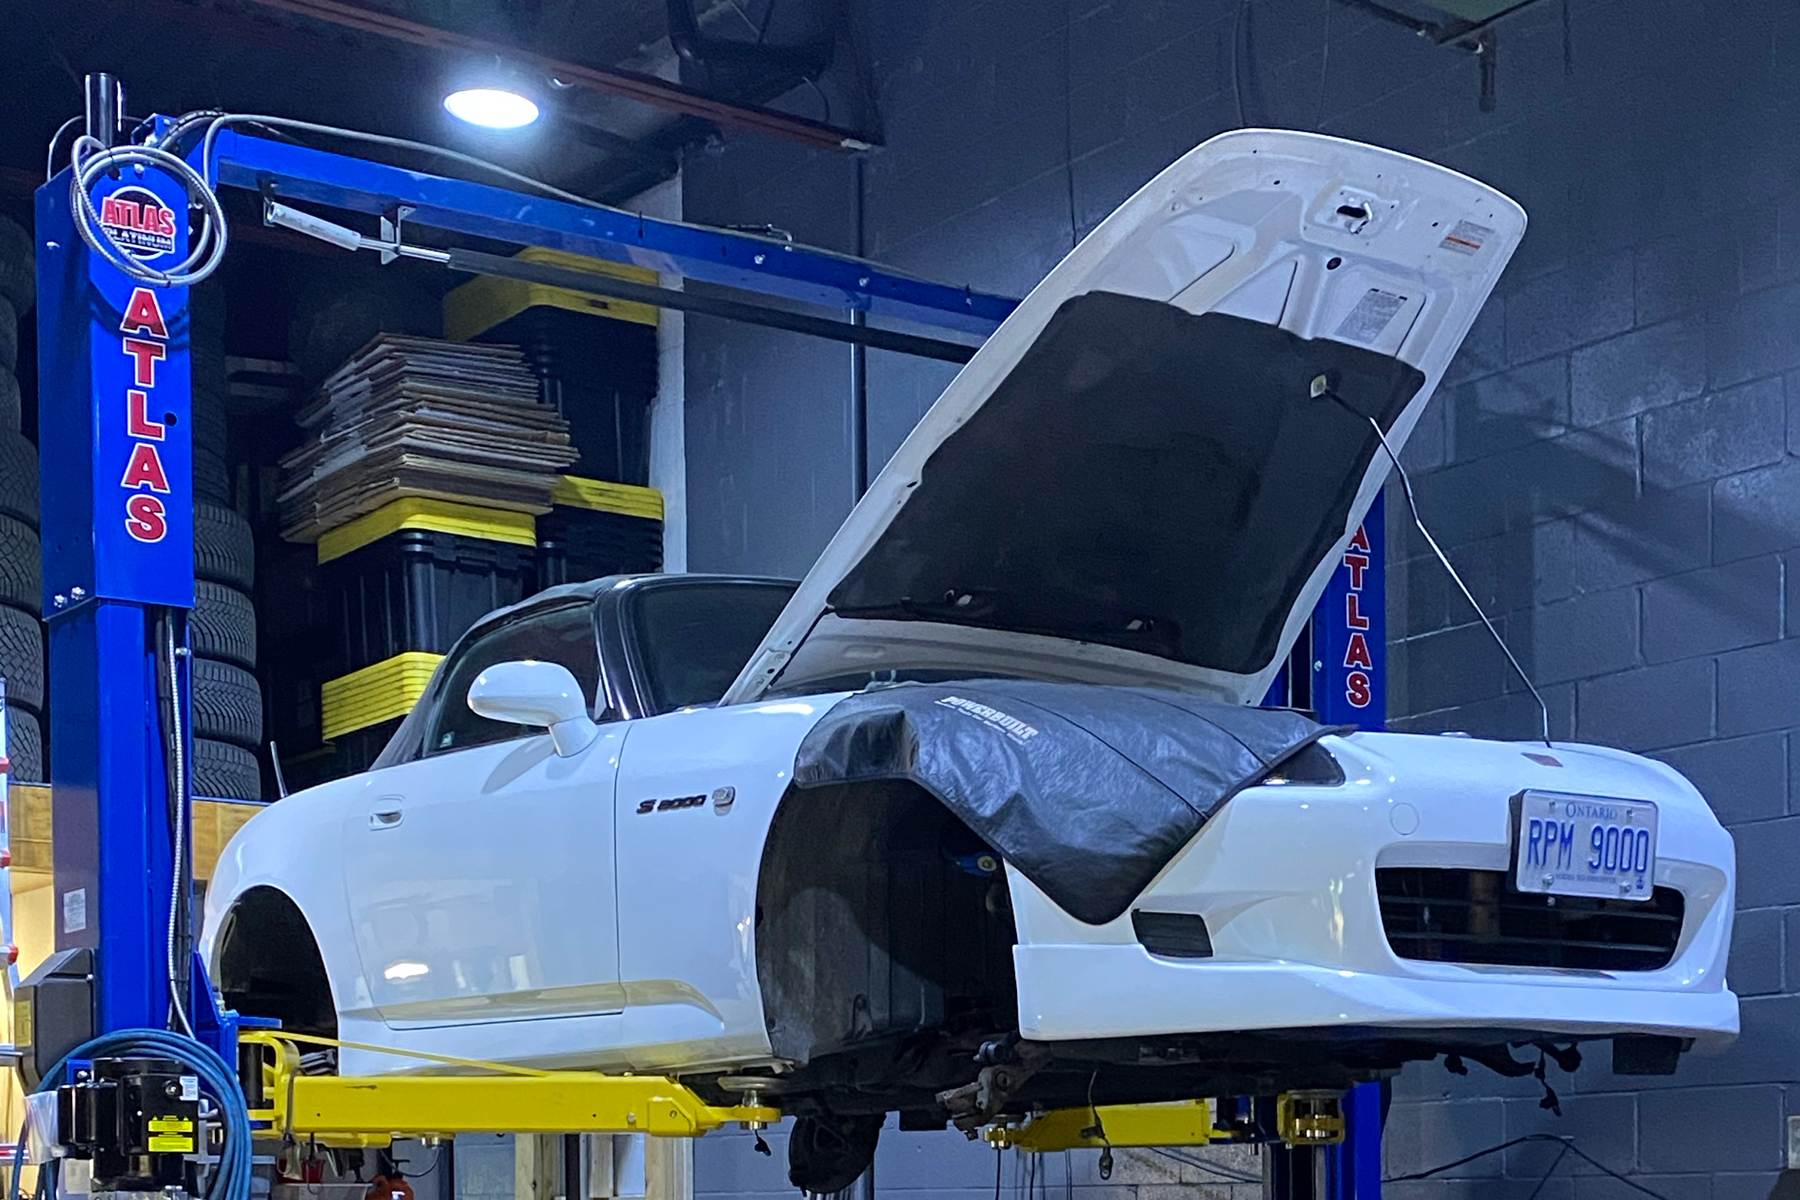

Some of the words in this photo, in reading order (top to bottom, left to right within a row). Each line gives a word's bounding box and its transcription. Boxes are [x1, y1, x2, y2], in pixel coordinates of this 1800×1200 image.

[101, 196, 176, 238] ATLAS
[120, 287, 171, 543] ATLAS
[1565, 801, 1618, 821] ONTARIO
[1527, 818, 1575, 869] RPM
[1588, 825, 1650, 874] 9000
